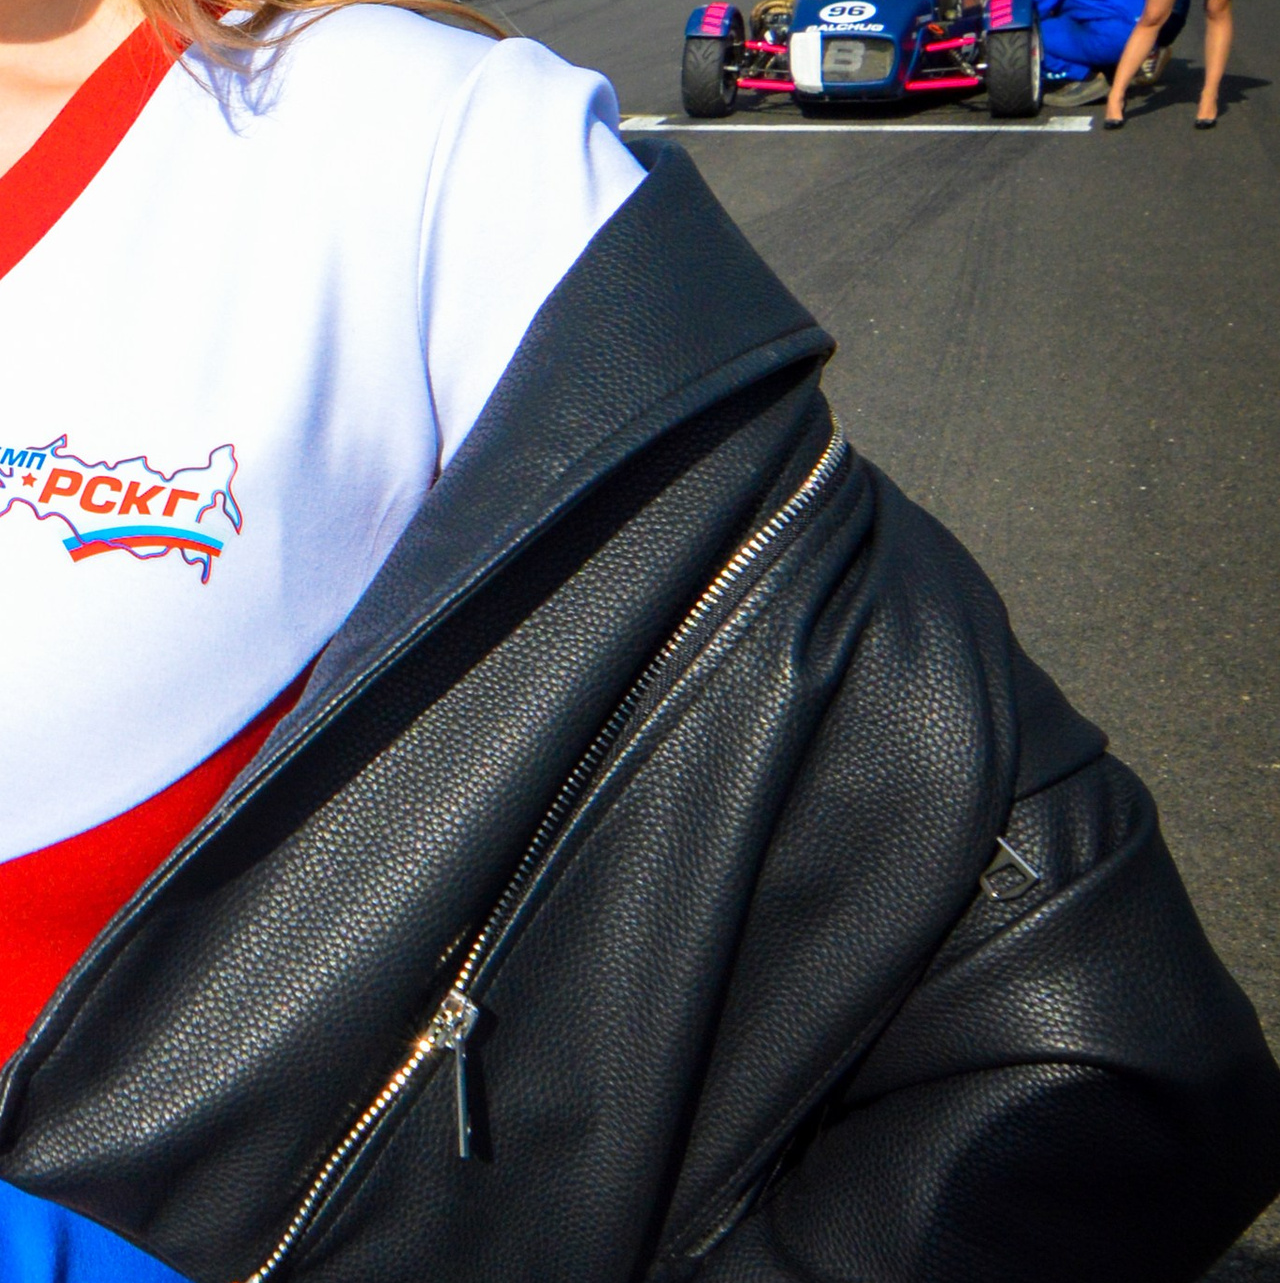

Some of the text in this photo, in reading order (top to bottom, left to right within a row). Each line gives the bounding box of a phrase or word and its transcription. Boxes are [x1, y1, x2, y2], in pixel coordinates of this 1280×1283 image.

[828, 6, 867, 17] 96
[805, 24, 884, 33] BALCHUG
[38, 467, 200, 518] РСКГ
